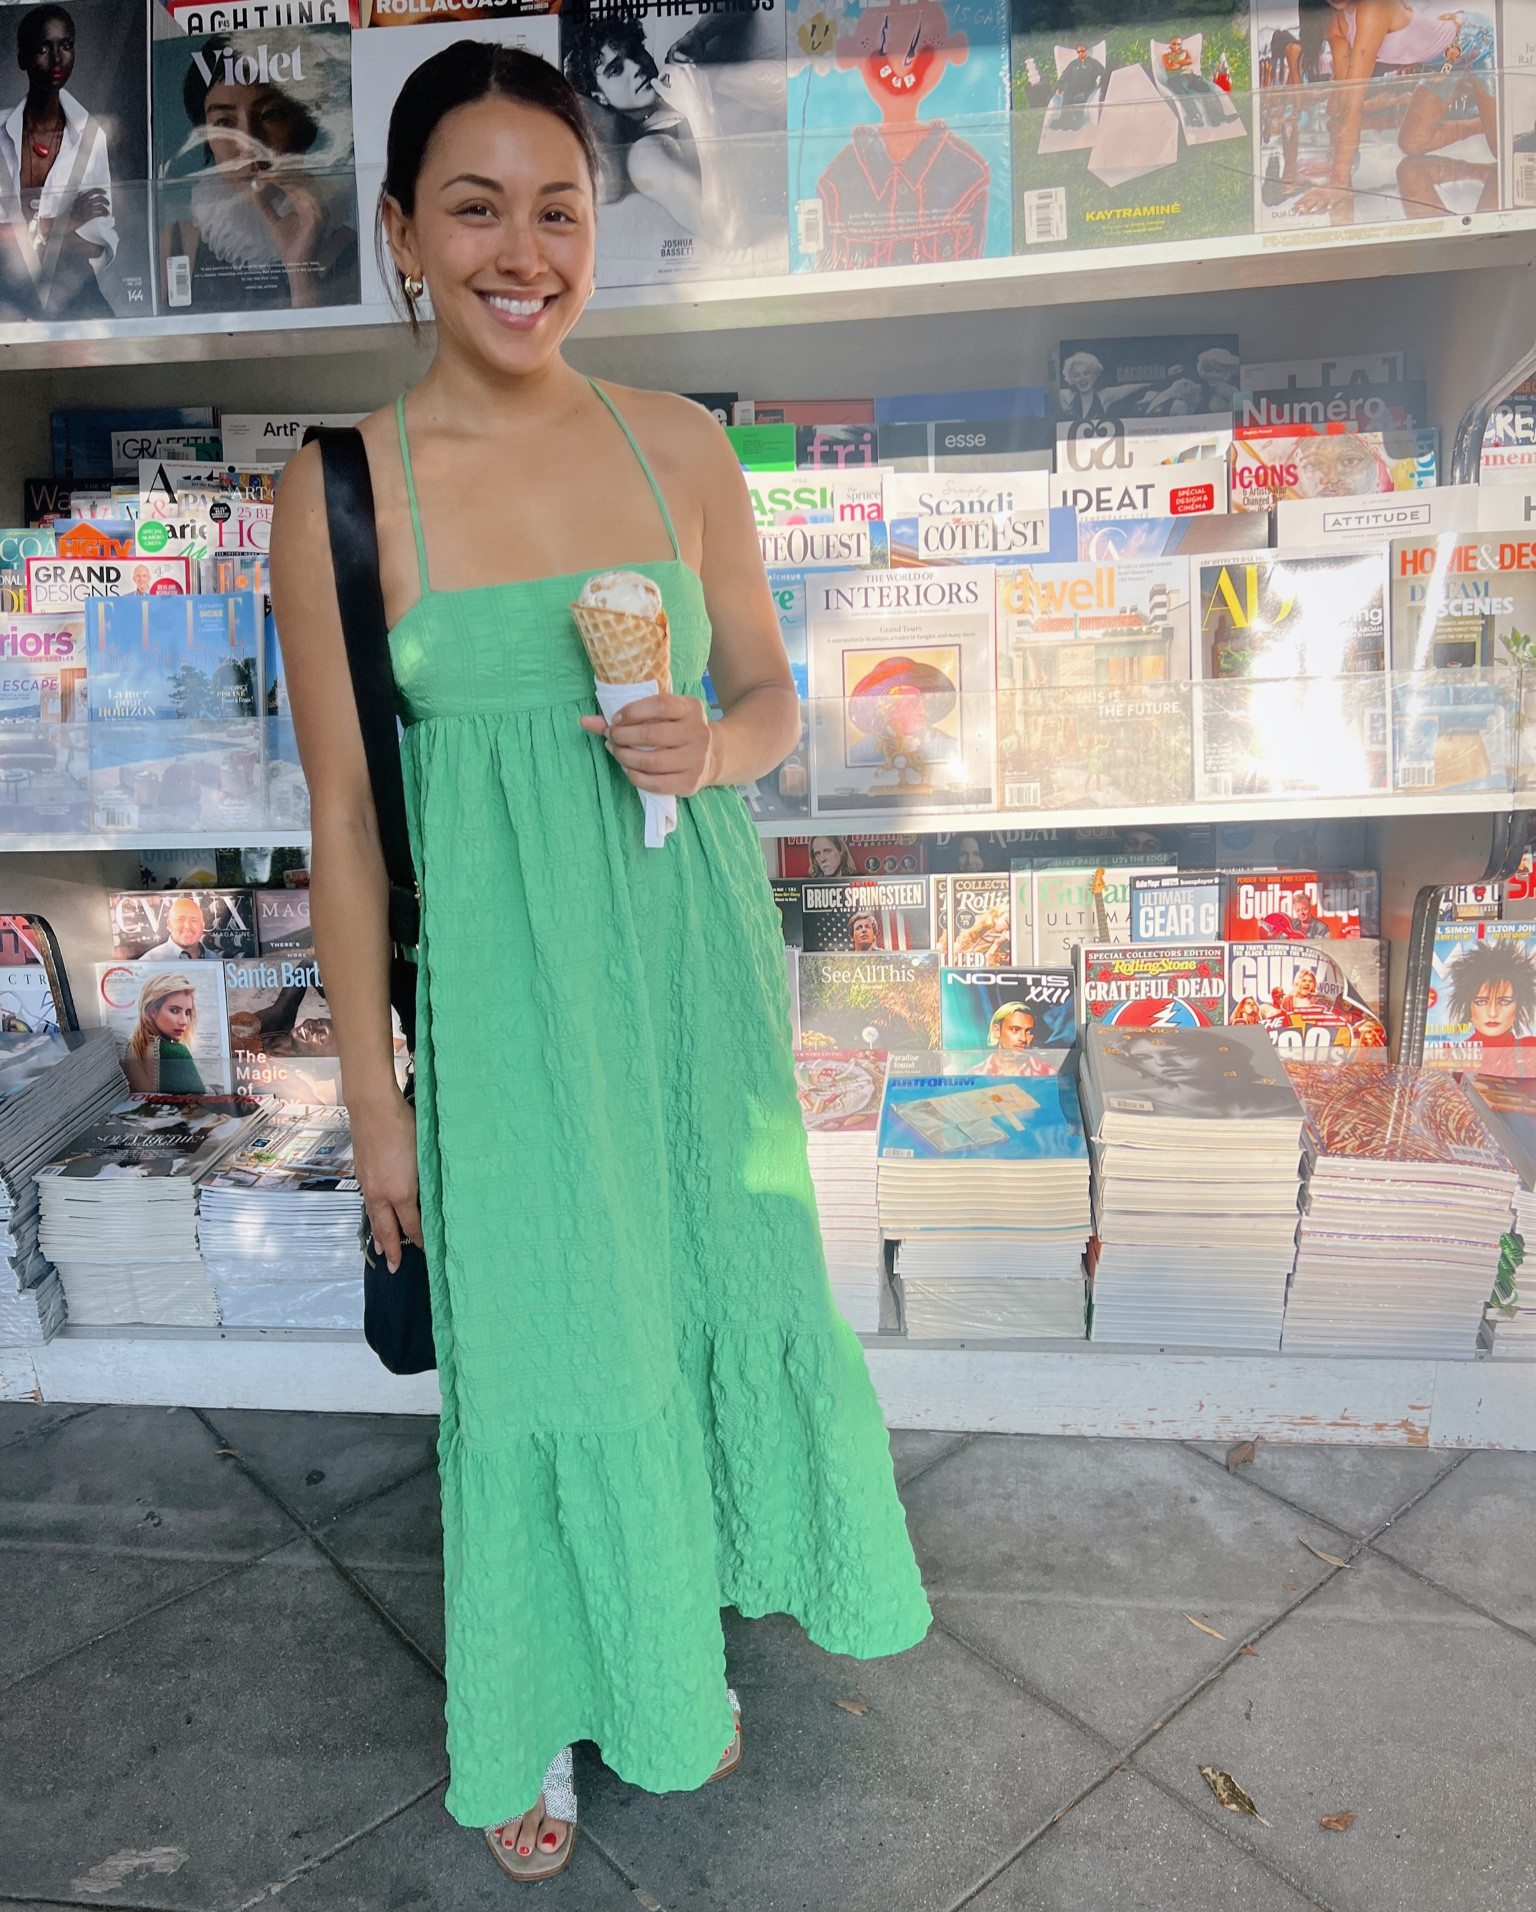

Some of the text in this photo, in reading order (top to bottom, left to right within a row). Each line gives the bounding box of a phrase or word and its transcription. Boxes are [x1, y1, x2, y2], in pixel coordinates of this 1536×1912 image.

[191, 43, 307, 89] Violet
[1086, 202, 1181, 222] KAYTRAMINÉ
[660, 247, 695, 257] BASSETT
[662, 238, 693, 249] JOSHUA
[1242, 392, 1386, 427] Numéro
[944, 431, 987, 447] esse
[1231, 463, 1299, 490] ICONS
[918, 491, 1013, 518] Scandi
[1062, 483, 1156, 514] IDEAT
[1175, 496, 1203, 505] DESIGN
[1242, 495, 1270, 506] Changed
[237, 508, 252, 518] 25
[1331, 510, 1421, 528] ATTITUDE
[59, 538, 134, 558] HGTV
[34, 566, 122, 584] GRAND
[865, 571, 935, 583] THE WORLD OF
[35, 584, 120, 602] DESIGNS
[823, 580, 979, 612] INTERIORS
[1001, 565, 1116, 615] dwell
[1437, 596, 1515, 618] SCENES
[98, 598, 245, 651] ELLE
[2, 679, 58, 692] ESCAPE
[98, 704, 156, 718] HORIZON
[1098, 701, 1181, 717] THE FUTURE
[806, 883, 922, 909] BRUCE SPRINGSTEEN
[1139, 889, 1195, 907] ULTIMATE
[1138, 904, 1195, 939] GEAR
[1445, 925, 1476, 935] SIMON
[1486, 923, 1514, 933] ELTON
[1088, 949, 1222, 960] SPECIAL COLLECTORS EDITION
[227, 962, 280, 988] Santa
[946, 972, 1070, 987] NOCTIS
[1084, 977, 1226, 1002] GRATEFUL DEAD
[1260, 1015, 1285, 1029] THE
[235, 1050, 267, 1064] The
[889, 1053, 920, 1062] Paradise
[893, 1061, 915, 1070] found
[236, 1066, 289, 1085] Magic
[890, 1076, 976, 1089] ARTFORUM
[237, 1083, 254, 1096] of
